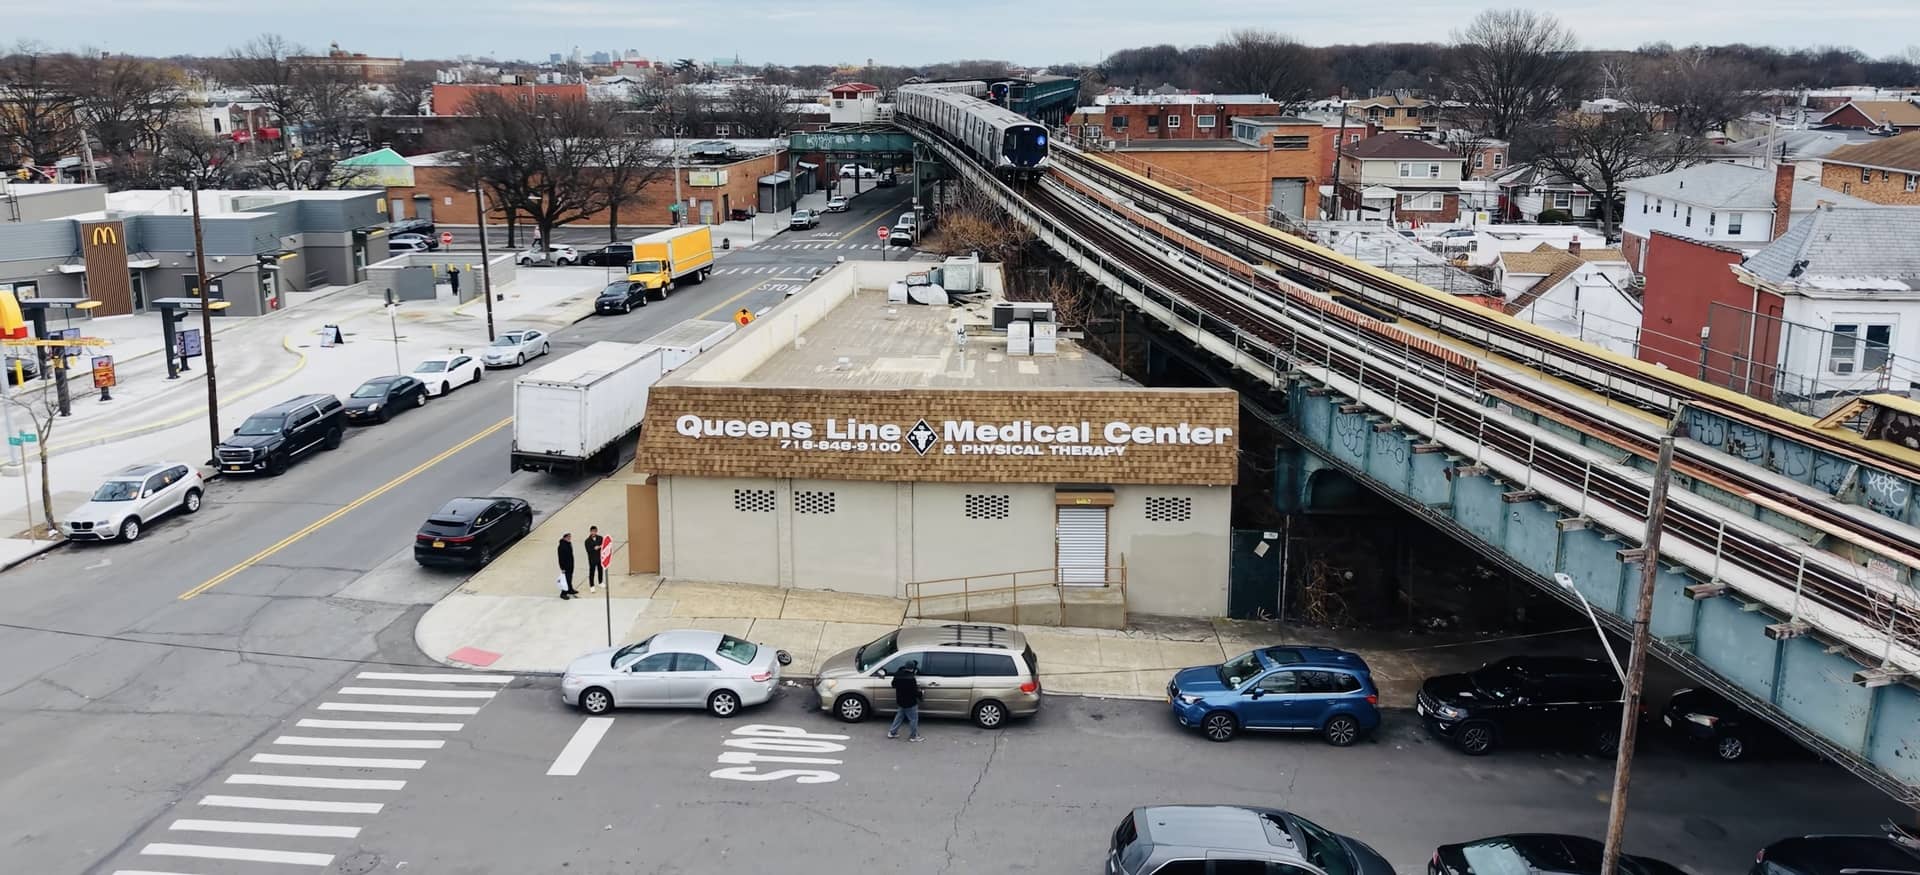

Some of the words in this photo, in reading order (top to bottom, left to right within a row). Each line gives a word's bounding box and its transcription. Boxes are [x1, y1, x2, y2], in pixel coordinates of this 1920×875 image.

[676, 414, 813, 438] Queens
[826, 418, 902, 441] Line
[944, 420, 1090, 443] Medical
[1104, 422, 1233, 445] Center
[780, 440, 902, 452] 718-848-9100
[944, 444, 955, 454] &
[961, 445, 1044, 455] PHYSICAL
[1049, 446, 1127, 457] THERAPY
[709, 724, 851, 784] STOP
